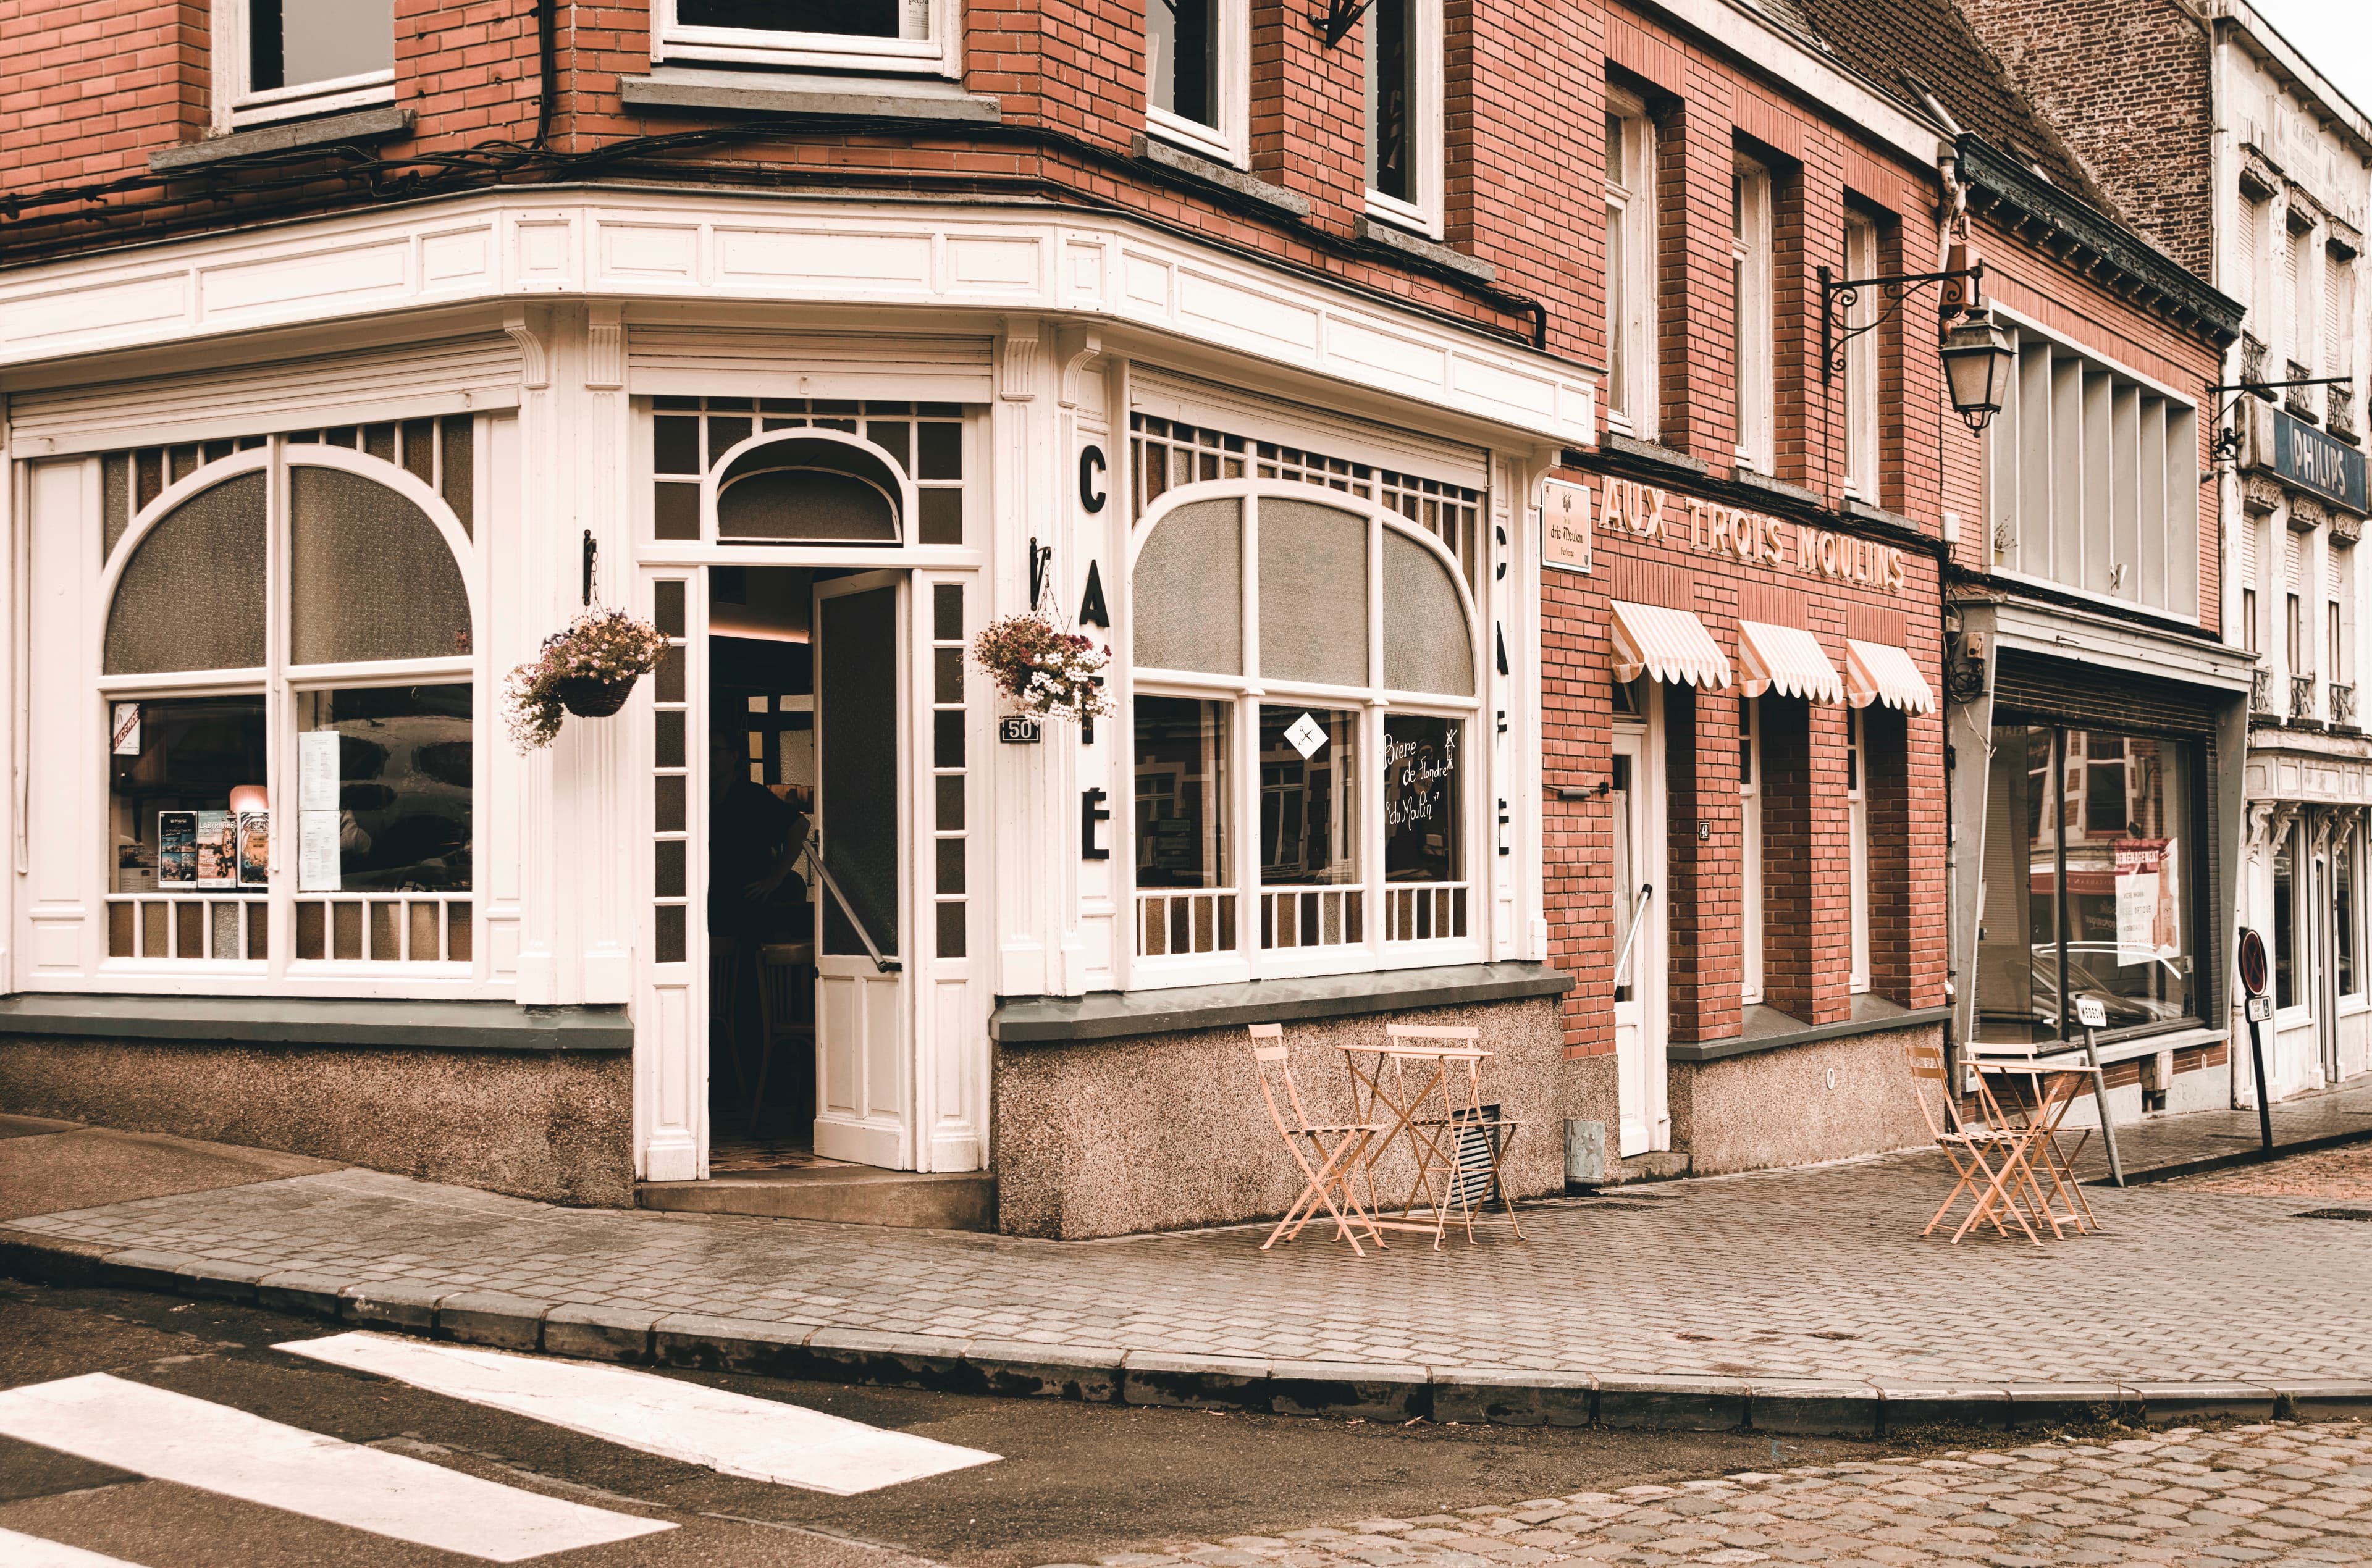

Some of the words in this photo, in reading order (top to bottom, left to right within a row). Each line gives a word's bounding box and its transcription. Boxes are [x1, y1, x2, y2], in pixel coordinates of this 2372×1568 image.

[2294, 428, 2346, 496] PHILIPS
[1599, 475, 1666, 542] AUX
[1685, 497, 1783, 566] TROIS
[1797, 524, 1904, 593] MOULINS
[115, 710, 139, 748] LICENCE
[1009, 720, 1032, 739] 50
[1403, 761, 1416, 786] de
[1701, 824, 1708, 837] 48
[2116, 849, 2160, 865] DÉMÉNAGEMENT
[2134, 905, 2151, 914] OPTIQUE
[2080, 1005, 2104, 1018] MÉDECIN
